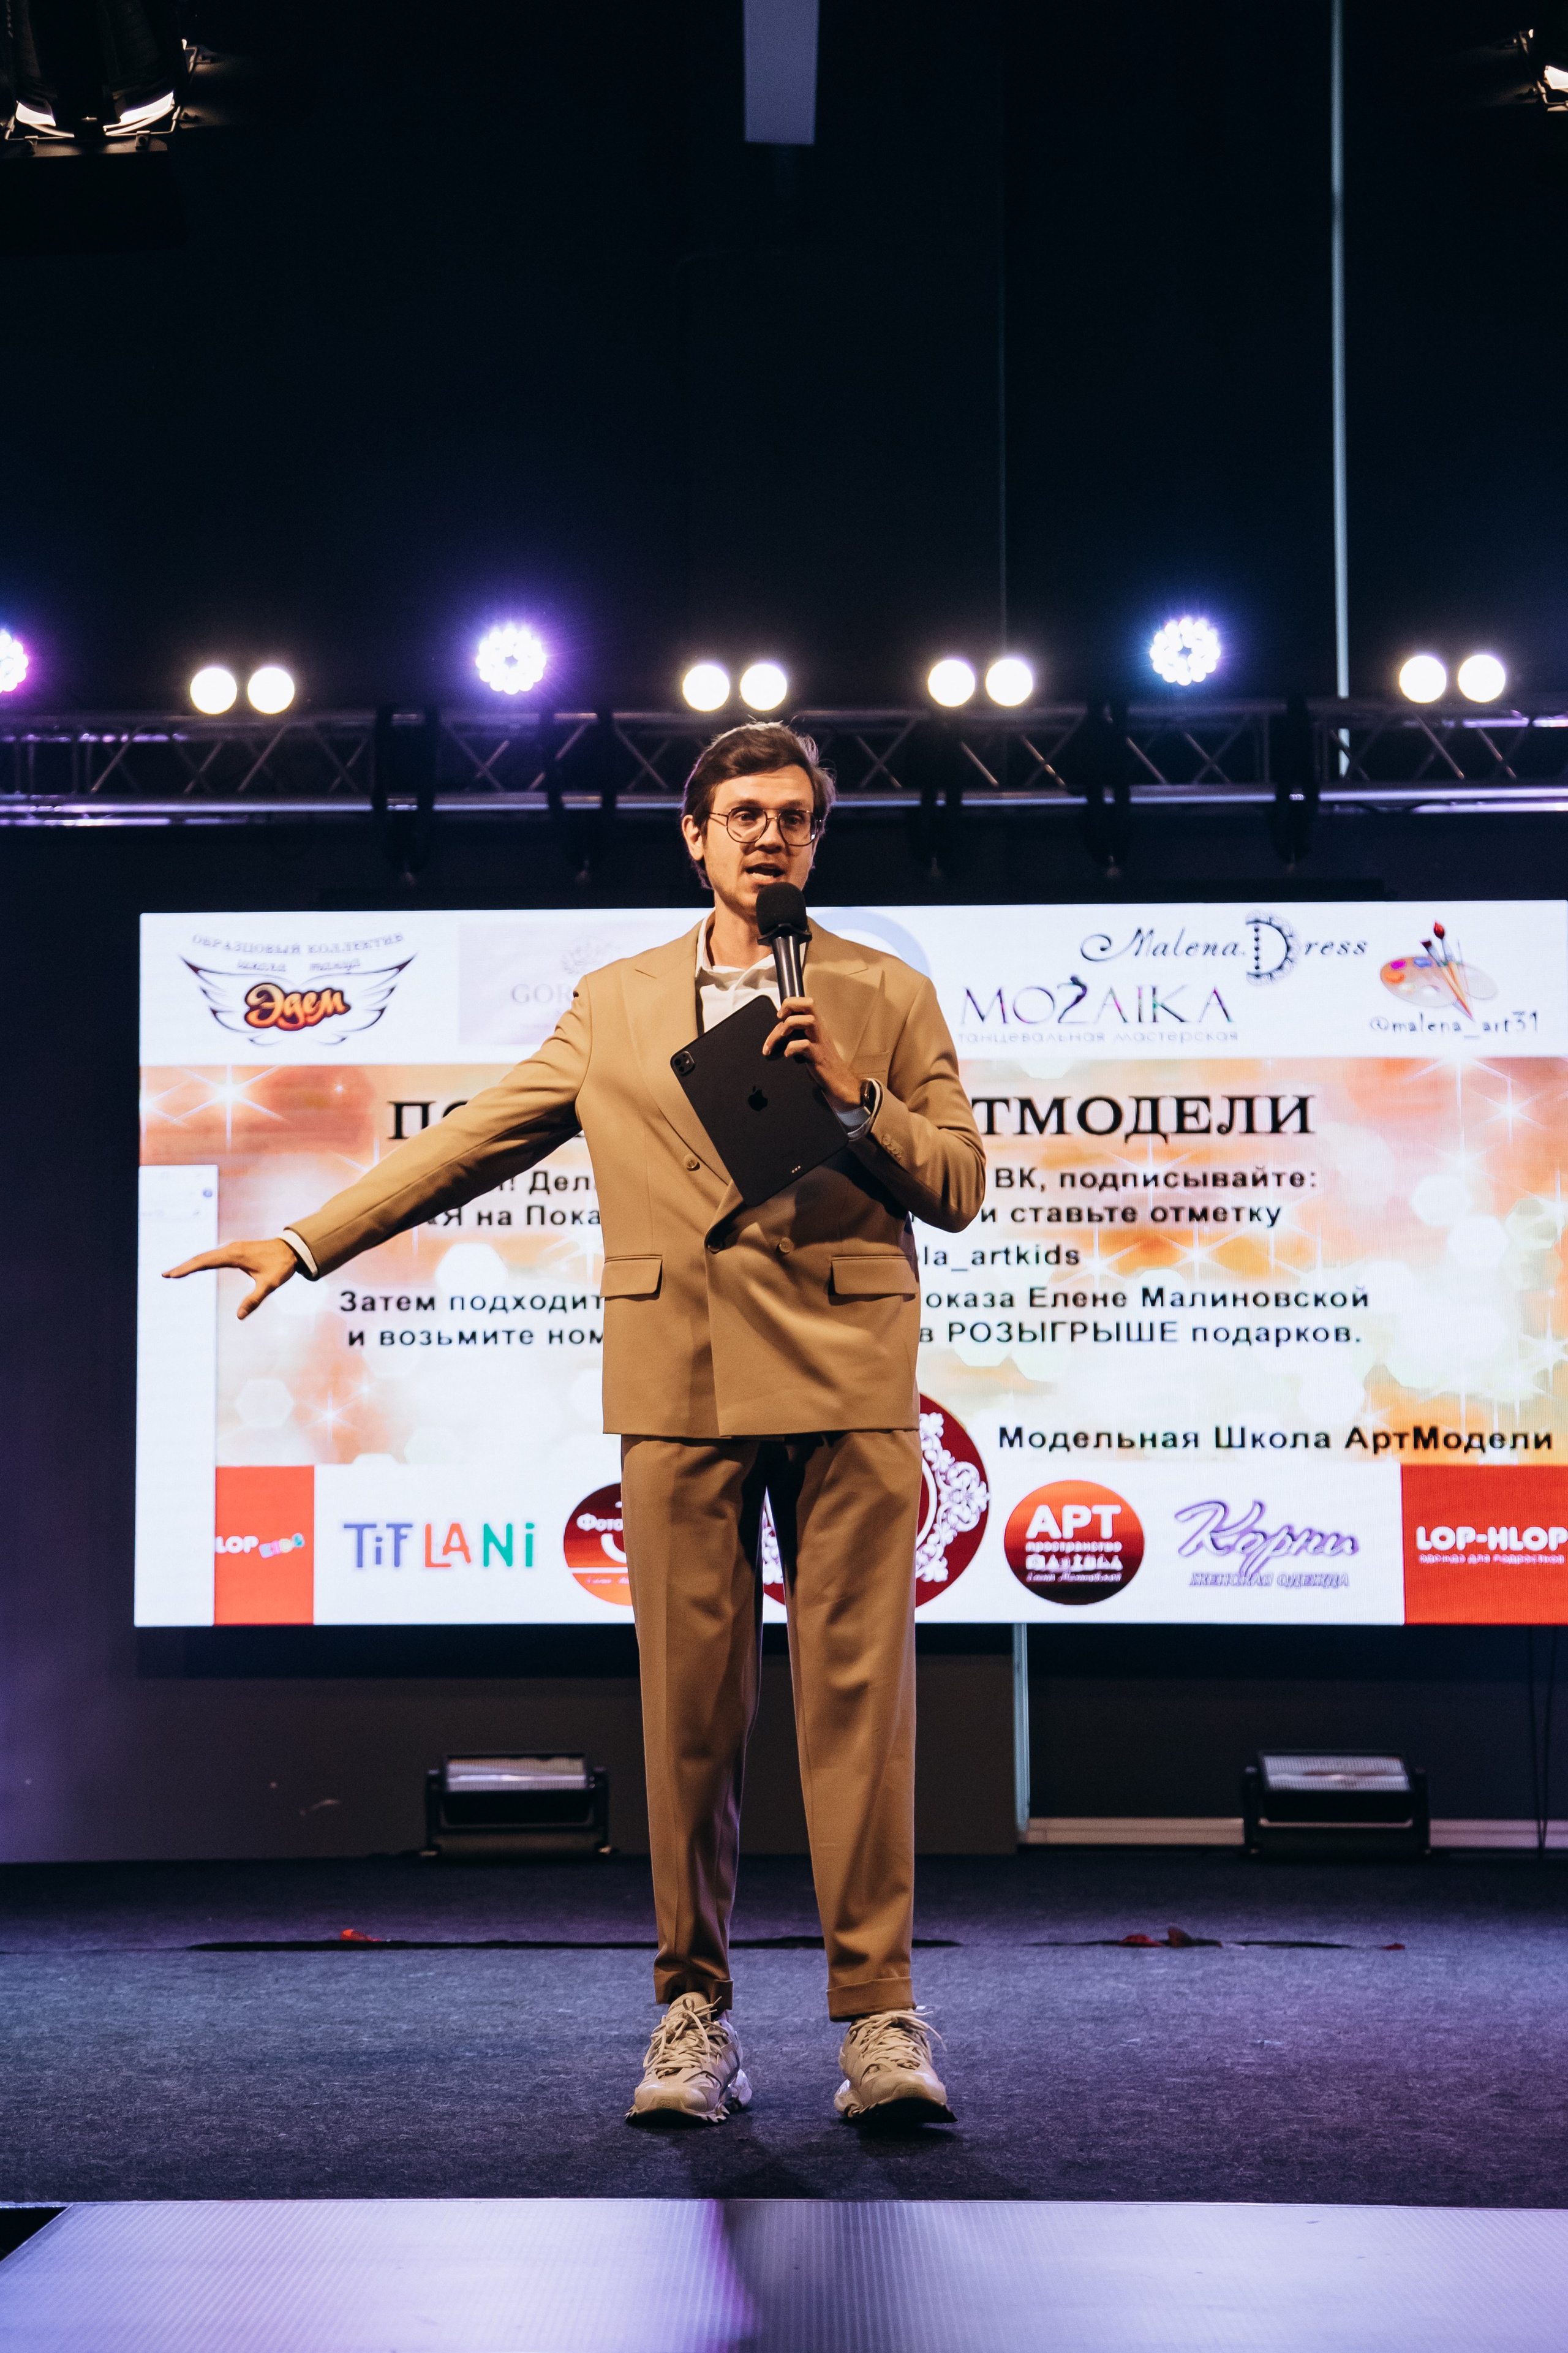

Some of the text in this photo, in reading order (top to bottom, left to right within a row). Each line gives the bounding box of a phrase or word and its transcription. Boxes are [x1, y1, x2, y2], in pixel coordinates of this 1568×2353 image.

[244, 981, 351, 1032] Эдем
[958, 1031, 1238, 1046] танцевальная мастерская
[995, 1165, 1317, 1192] ВК, подписывайте:
[477, 1209, 511, 1226] на
[981, 1204, 1283, 1227] и ставьте отметку
[919, 1245, 1080, 1272] la_artkids
[340, 1291, 436, 1312] Затем
[1029, 1287, 1127, 1308] Елене
[1143, 1286, 1368, 1308] Малиновской
[349, 1329, 365, 1346] и
[380, 1328, 533, 1346] возьмите
[948, 1321, 1178, 1343] РОЗЫГРЫШЕ
[1191, 1326, 1361, 1347] подарков.
[998, 1425, 1554, 1455] Модельная Школа АртМодели
[1025, 1505, 1121, 1539] АРТ
[1416, 1526, 1568, 1551] LOP-HLOP
